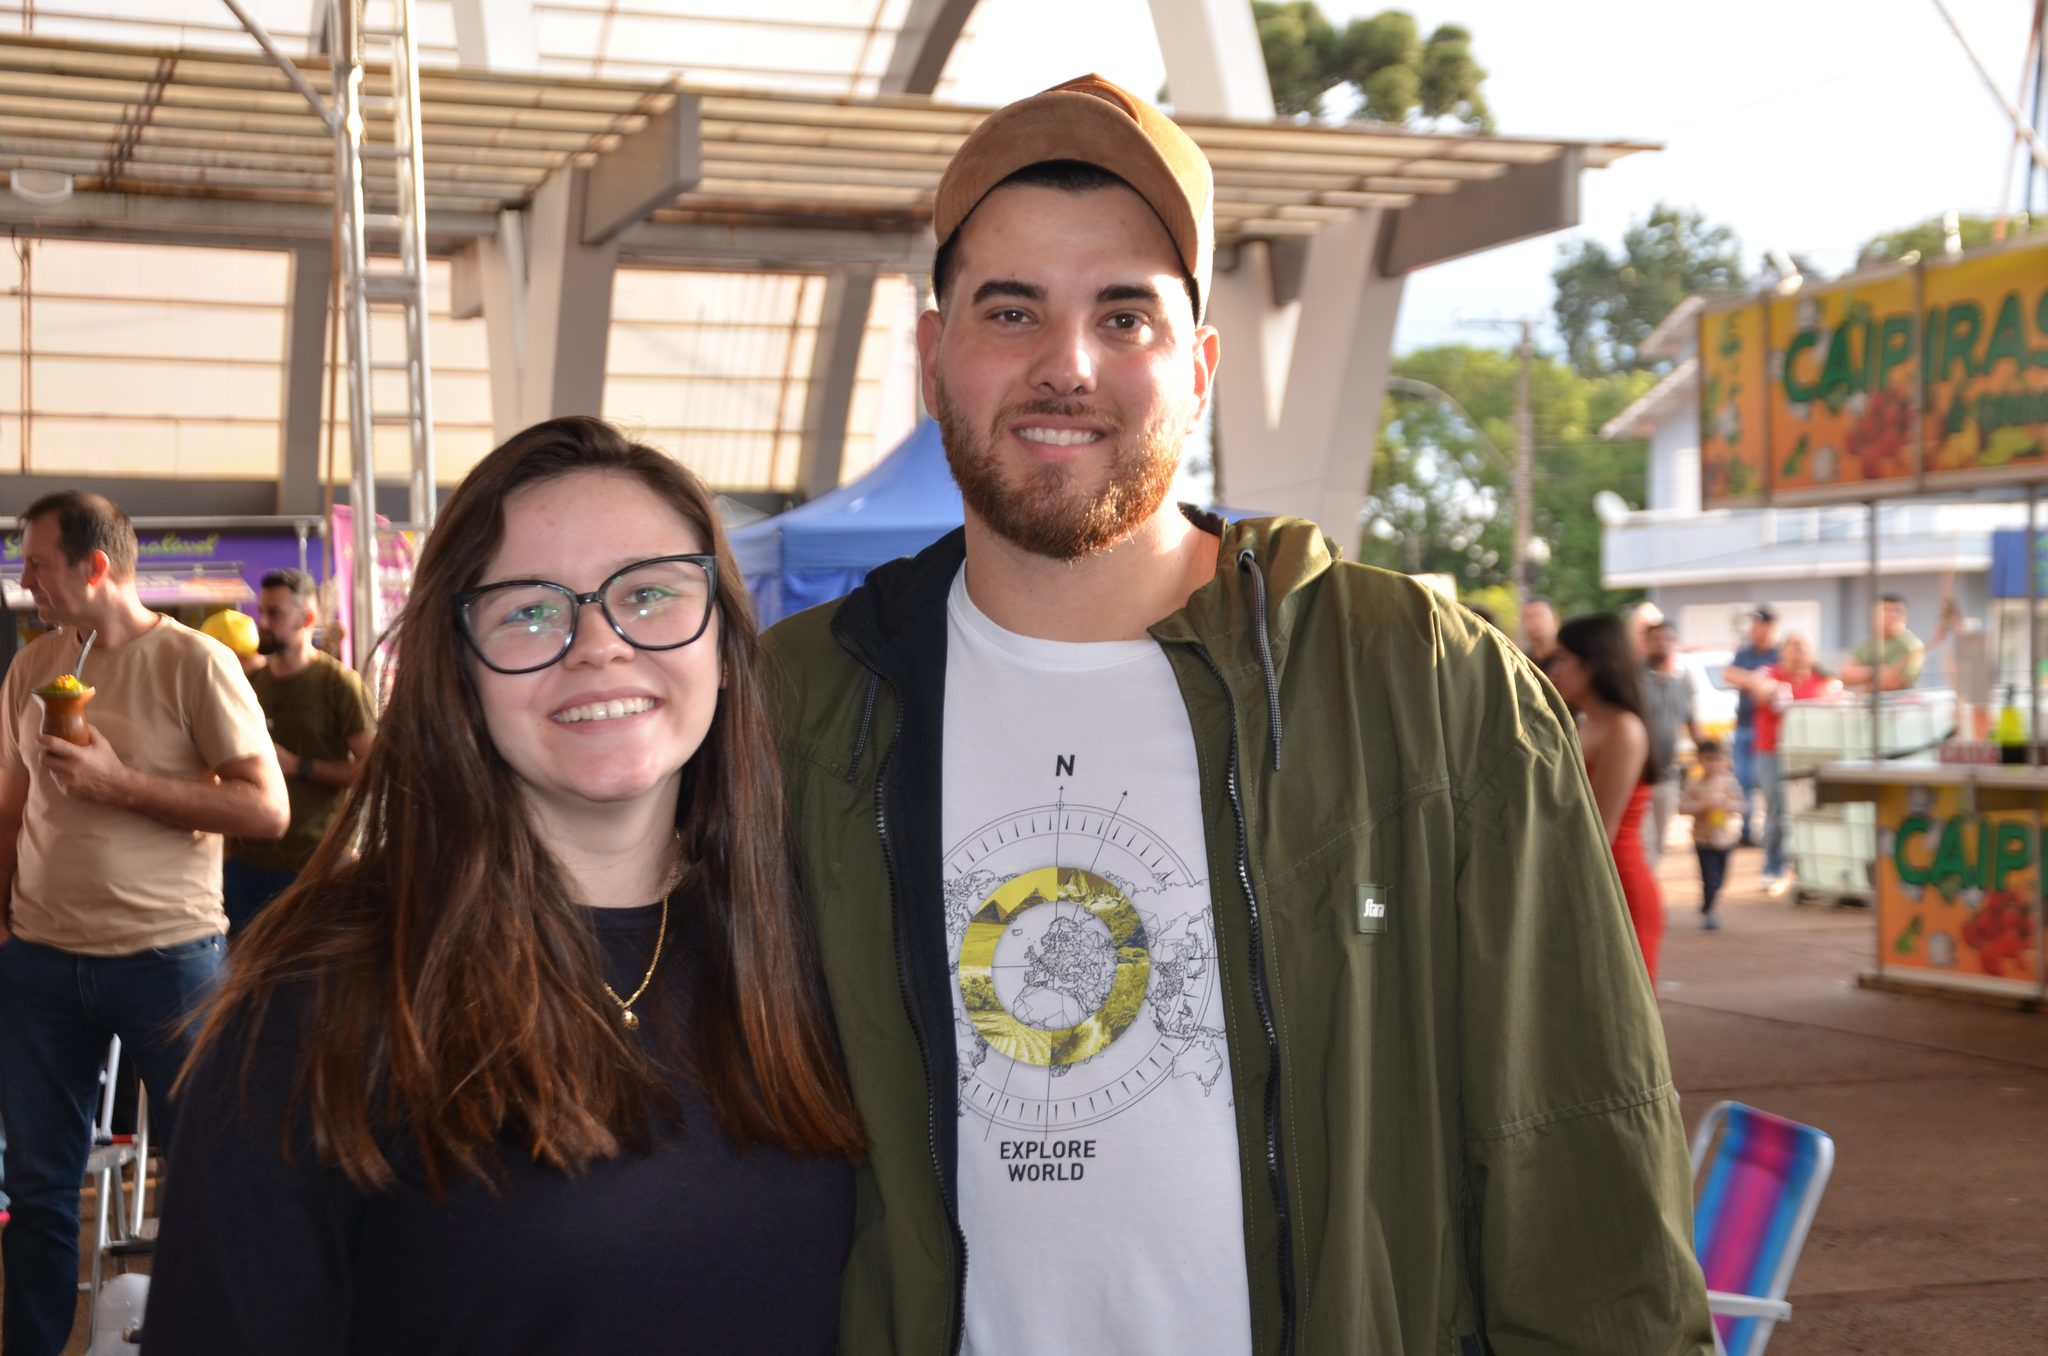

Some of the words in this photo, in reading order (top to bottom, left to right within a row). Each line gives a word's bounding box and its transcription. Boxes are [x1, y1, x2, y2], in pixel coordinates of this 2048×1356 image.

[1056, 754, 1076, 777] N
[1000, 1139, 1097, 1160] EXPLORE
[1007, 1162, 1085, 1182] WORLD
